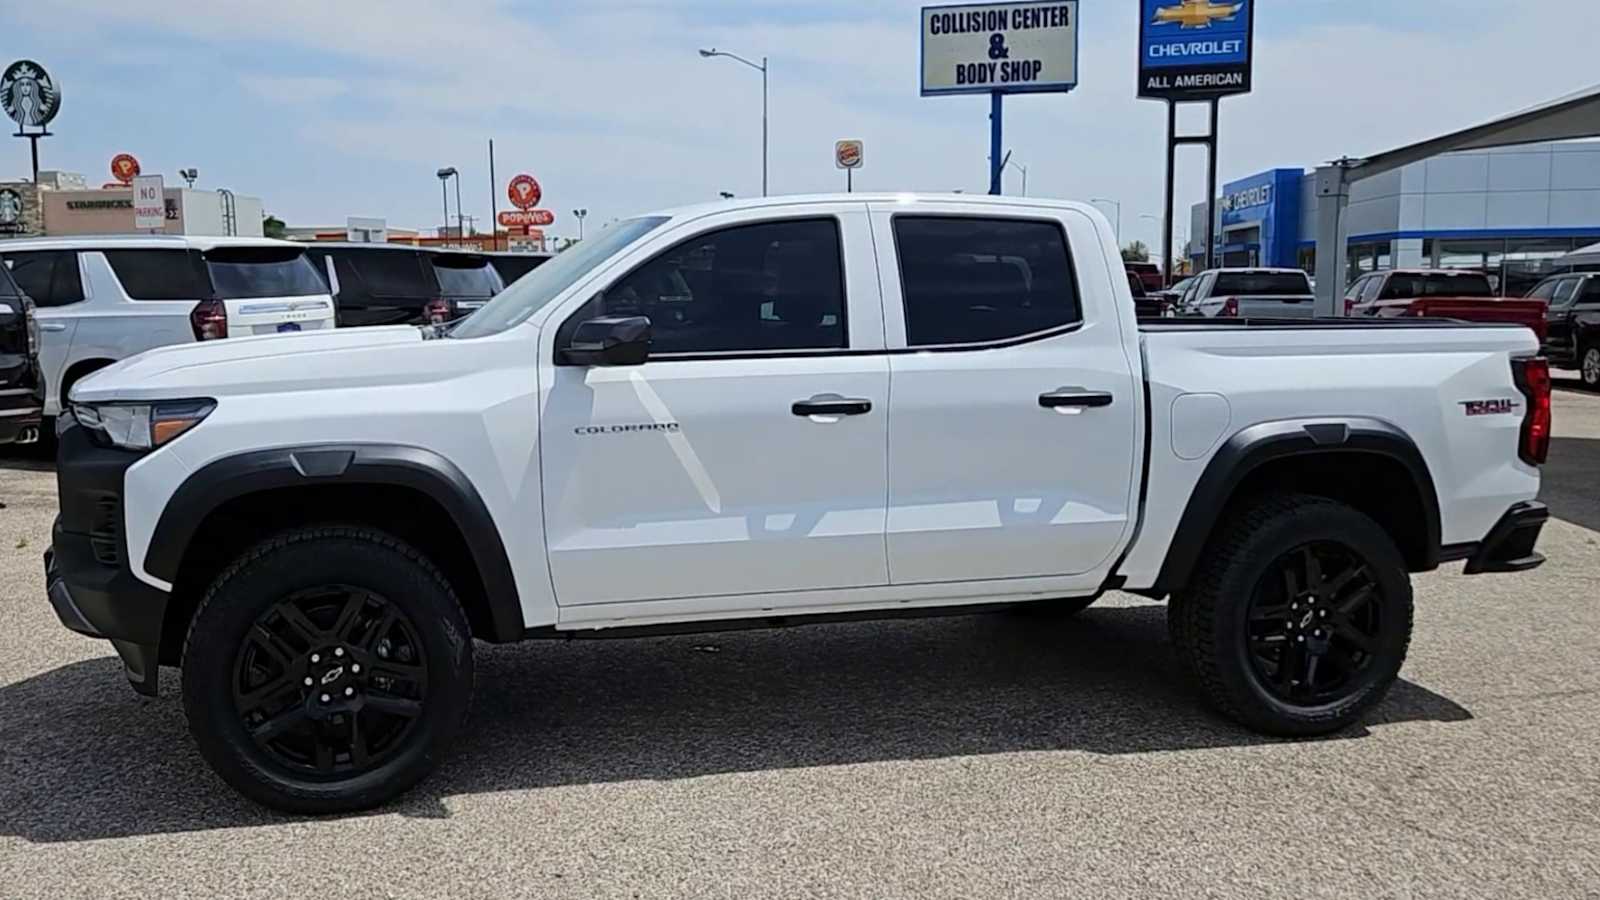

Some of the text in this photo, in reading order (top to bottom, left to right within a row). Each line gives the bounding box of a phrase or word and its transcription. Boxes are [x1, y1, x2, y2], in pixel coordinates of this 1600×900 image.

[930, 6, 1069, 35] COLLISION CENTER
[988, 33, 1009, 60] &
[1149, 40, 1242, 57] CHEVROLET
[956, 60, 1042, 85] BODY SHOP
[1147, 73, 1243, 88] ALL AMERICAN
[140, 186, 156, 200] NO
[1234, 184, 1272, 210] CHEVROLET
[135, 206, 165, 217] PARKING
[574, 422, 679, 435] COLORADO
